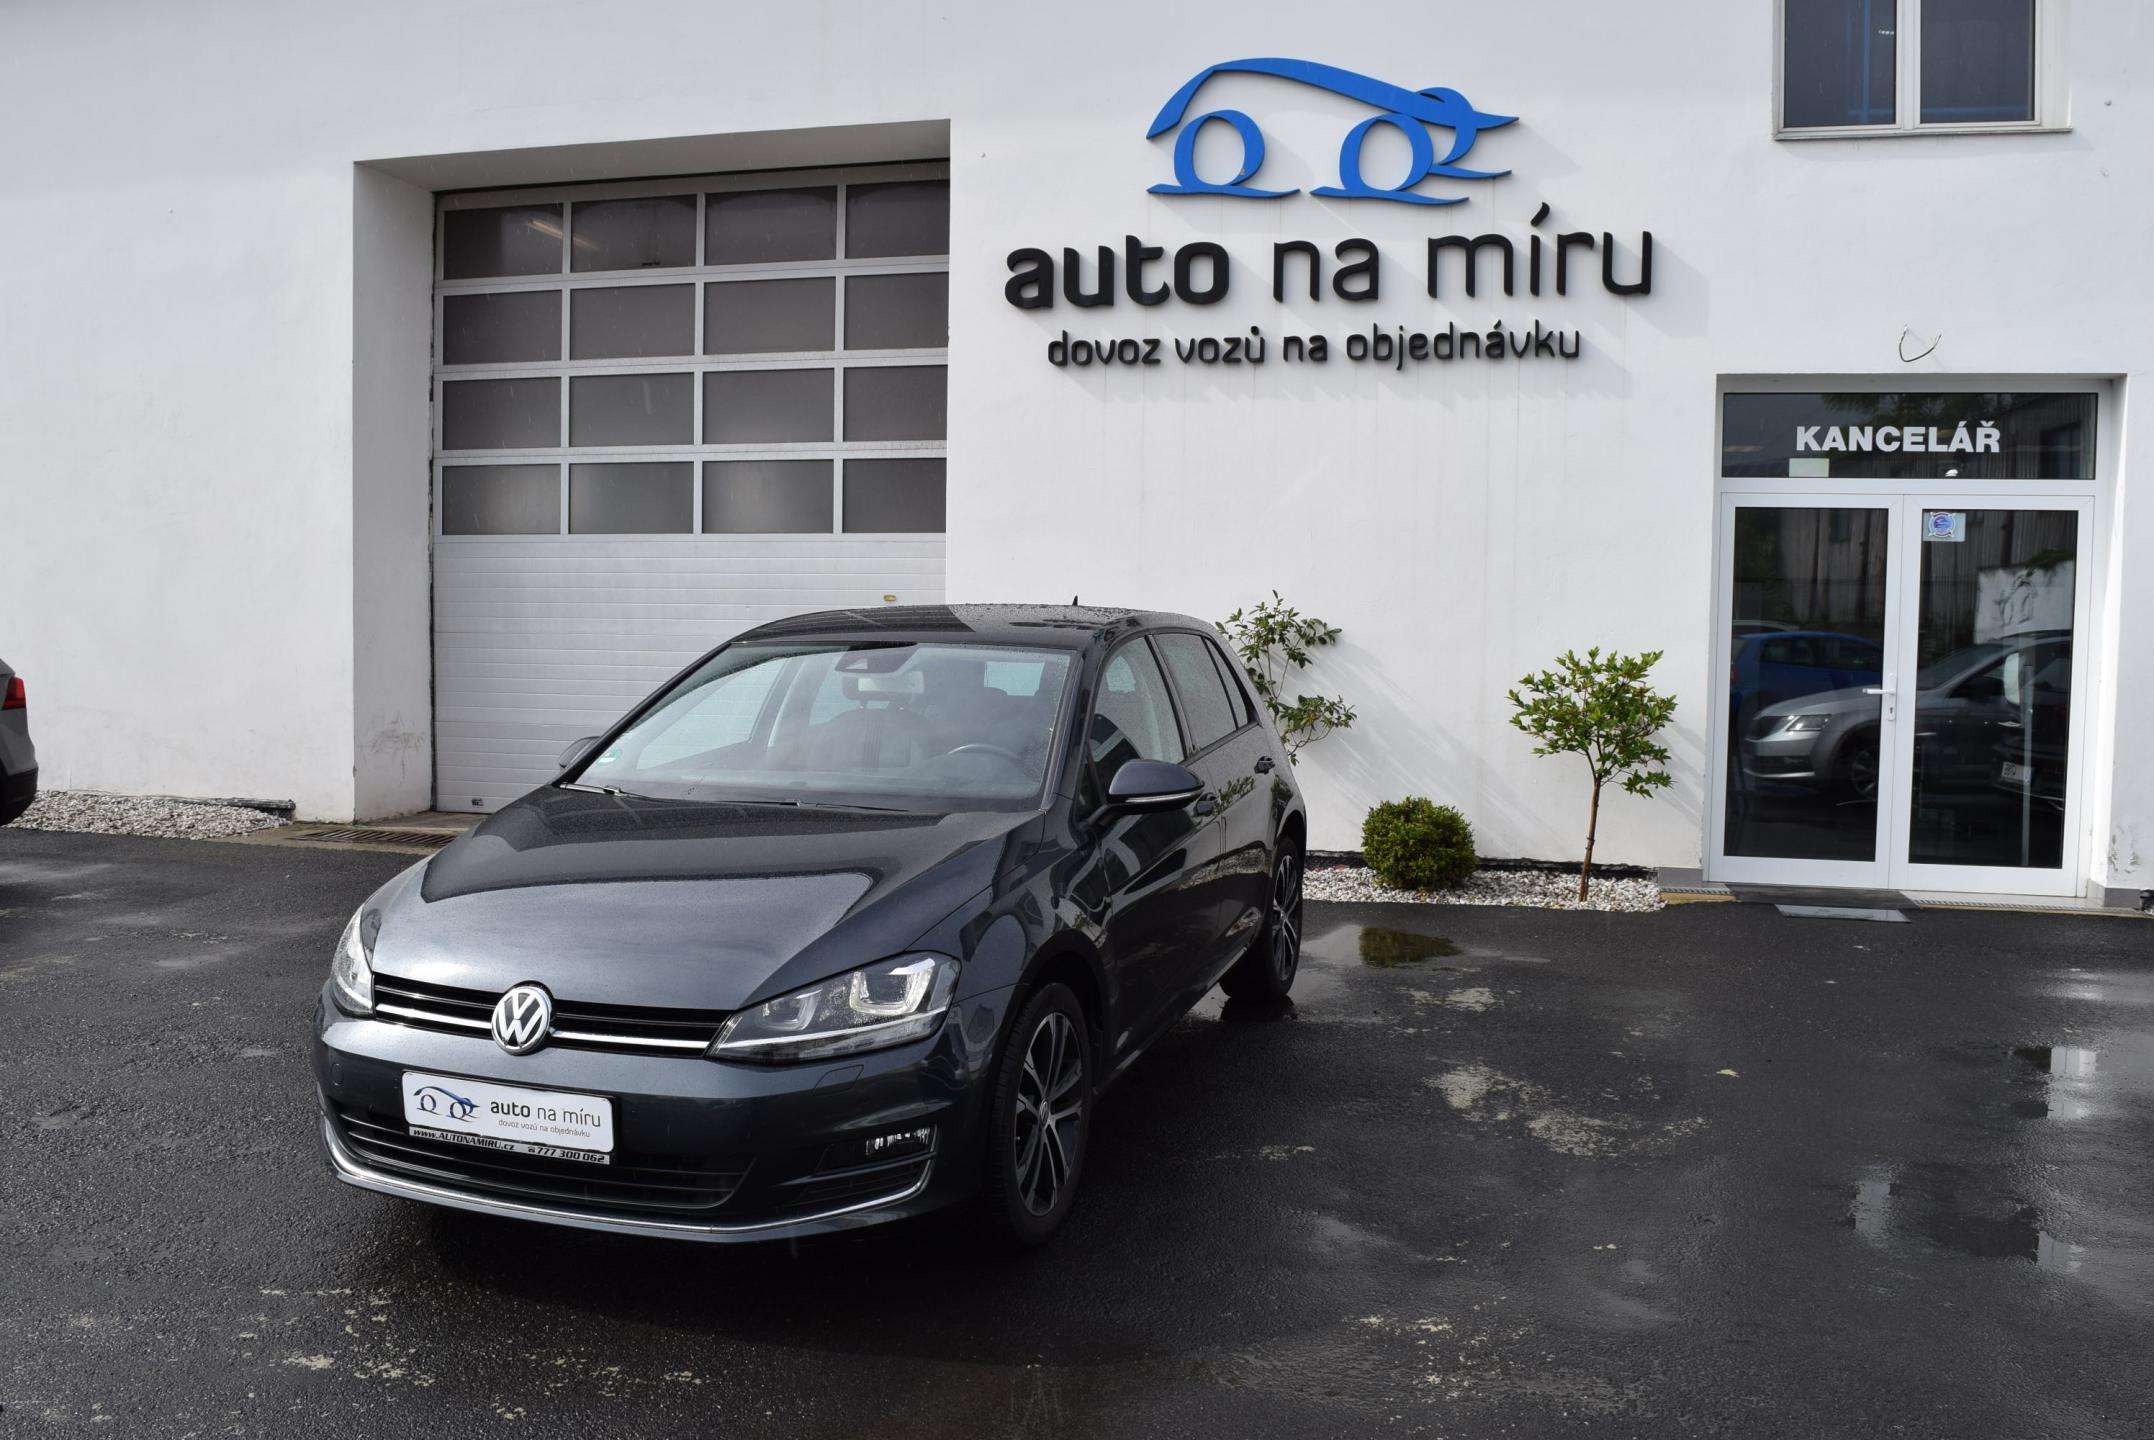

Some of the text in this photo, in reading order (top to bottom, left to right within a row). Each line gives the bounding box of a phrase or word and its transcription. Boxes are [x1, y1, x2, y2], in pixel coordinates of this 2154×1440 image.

[1004, 201, 1653, 309] auto na míru
[1047, 318, 1580, 371] dovoz vozů na objednávku
[1796, 420, 2001, 453] KANCELÁŘ
[490, 1101, 601, 1128] auto na míru
[498, 1119, 519, 1129] dovoz
[550, 1126, 591, 1138] objednávku
[559, 1150, 581, 1160] 300
[582, 1153, 605, 1163] 062
